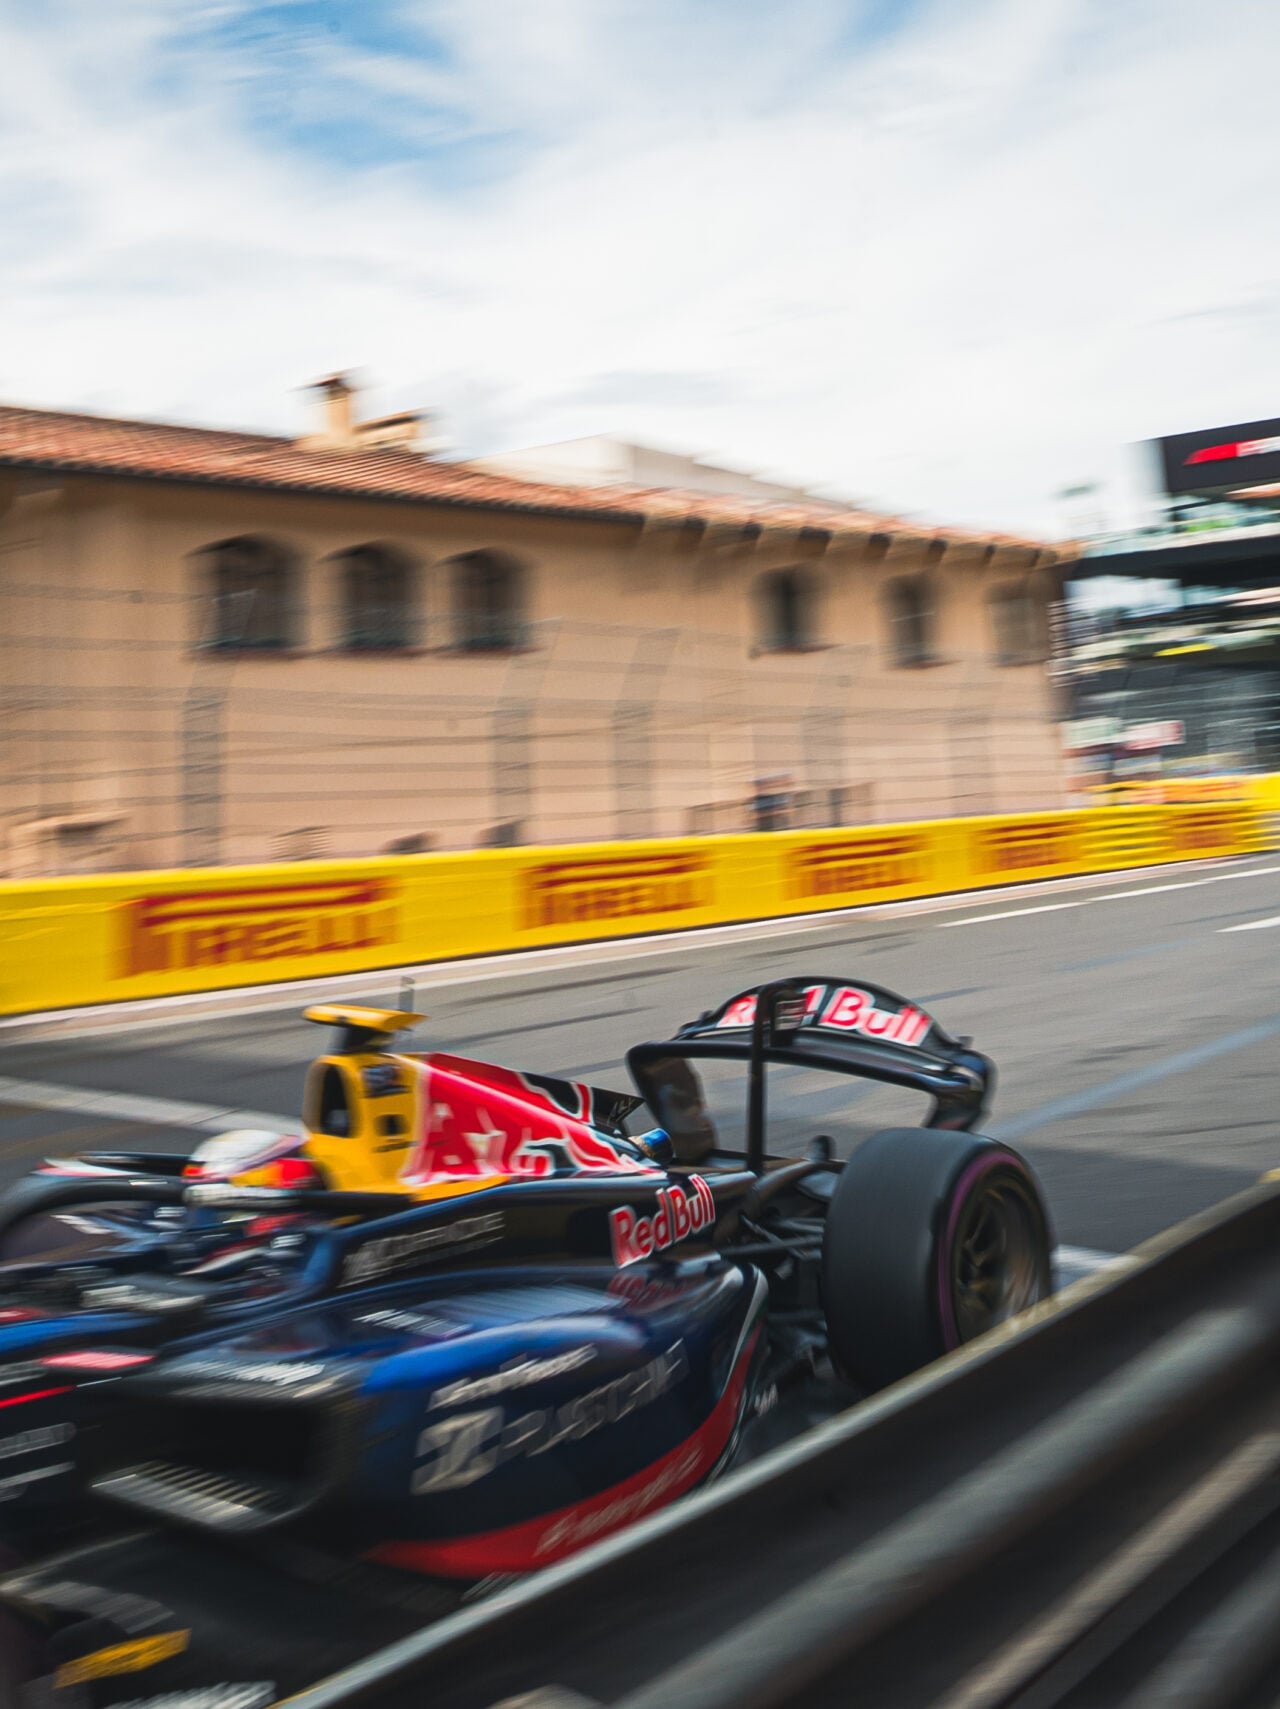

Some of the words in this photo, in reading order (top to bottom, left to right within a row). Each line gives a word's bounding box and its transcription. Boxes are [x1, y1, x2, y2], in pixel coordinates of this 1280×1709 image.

[112, 876, 402, 979] PIRELLI
[819, 987, 933, 1046] Bull
[609, 1187, 672, 1269] Red
[667, 1174, 715, 1242] Bull
